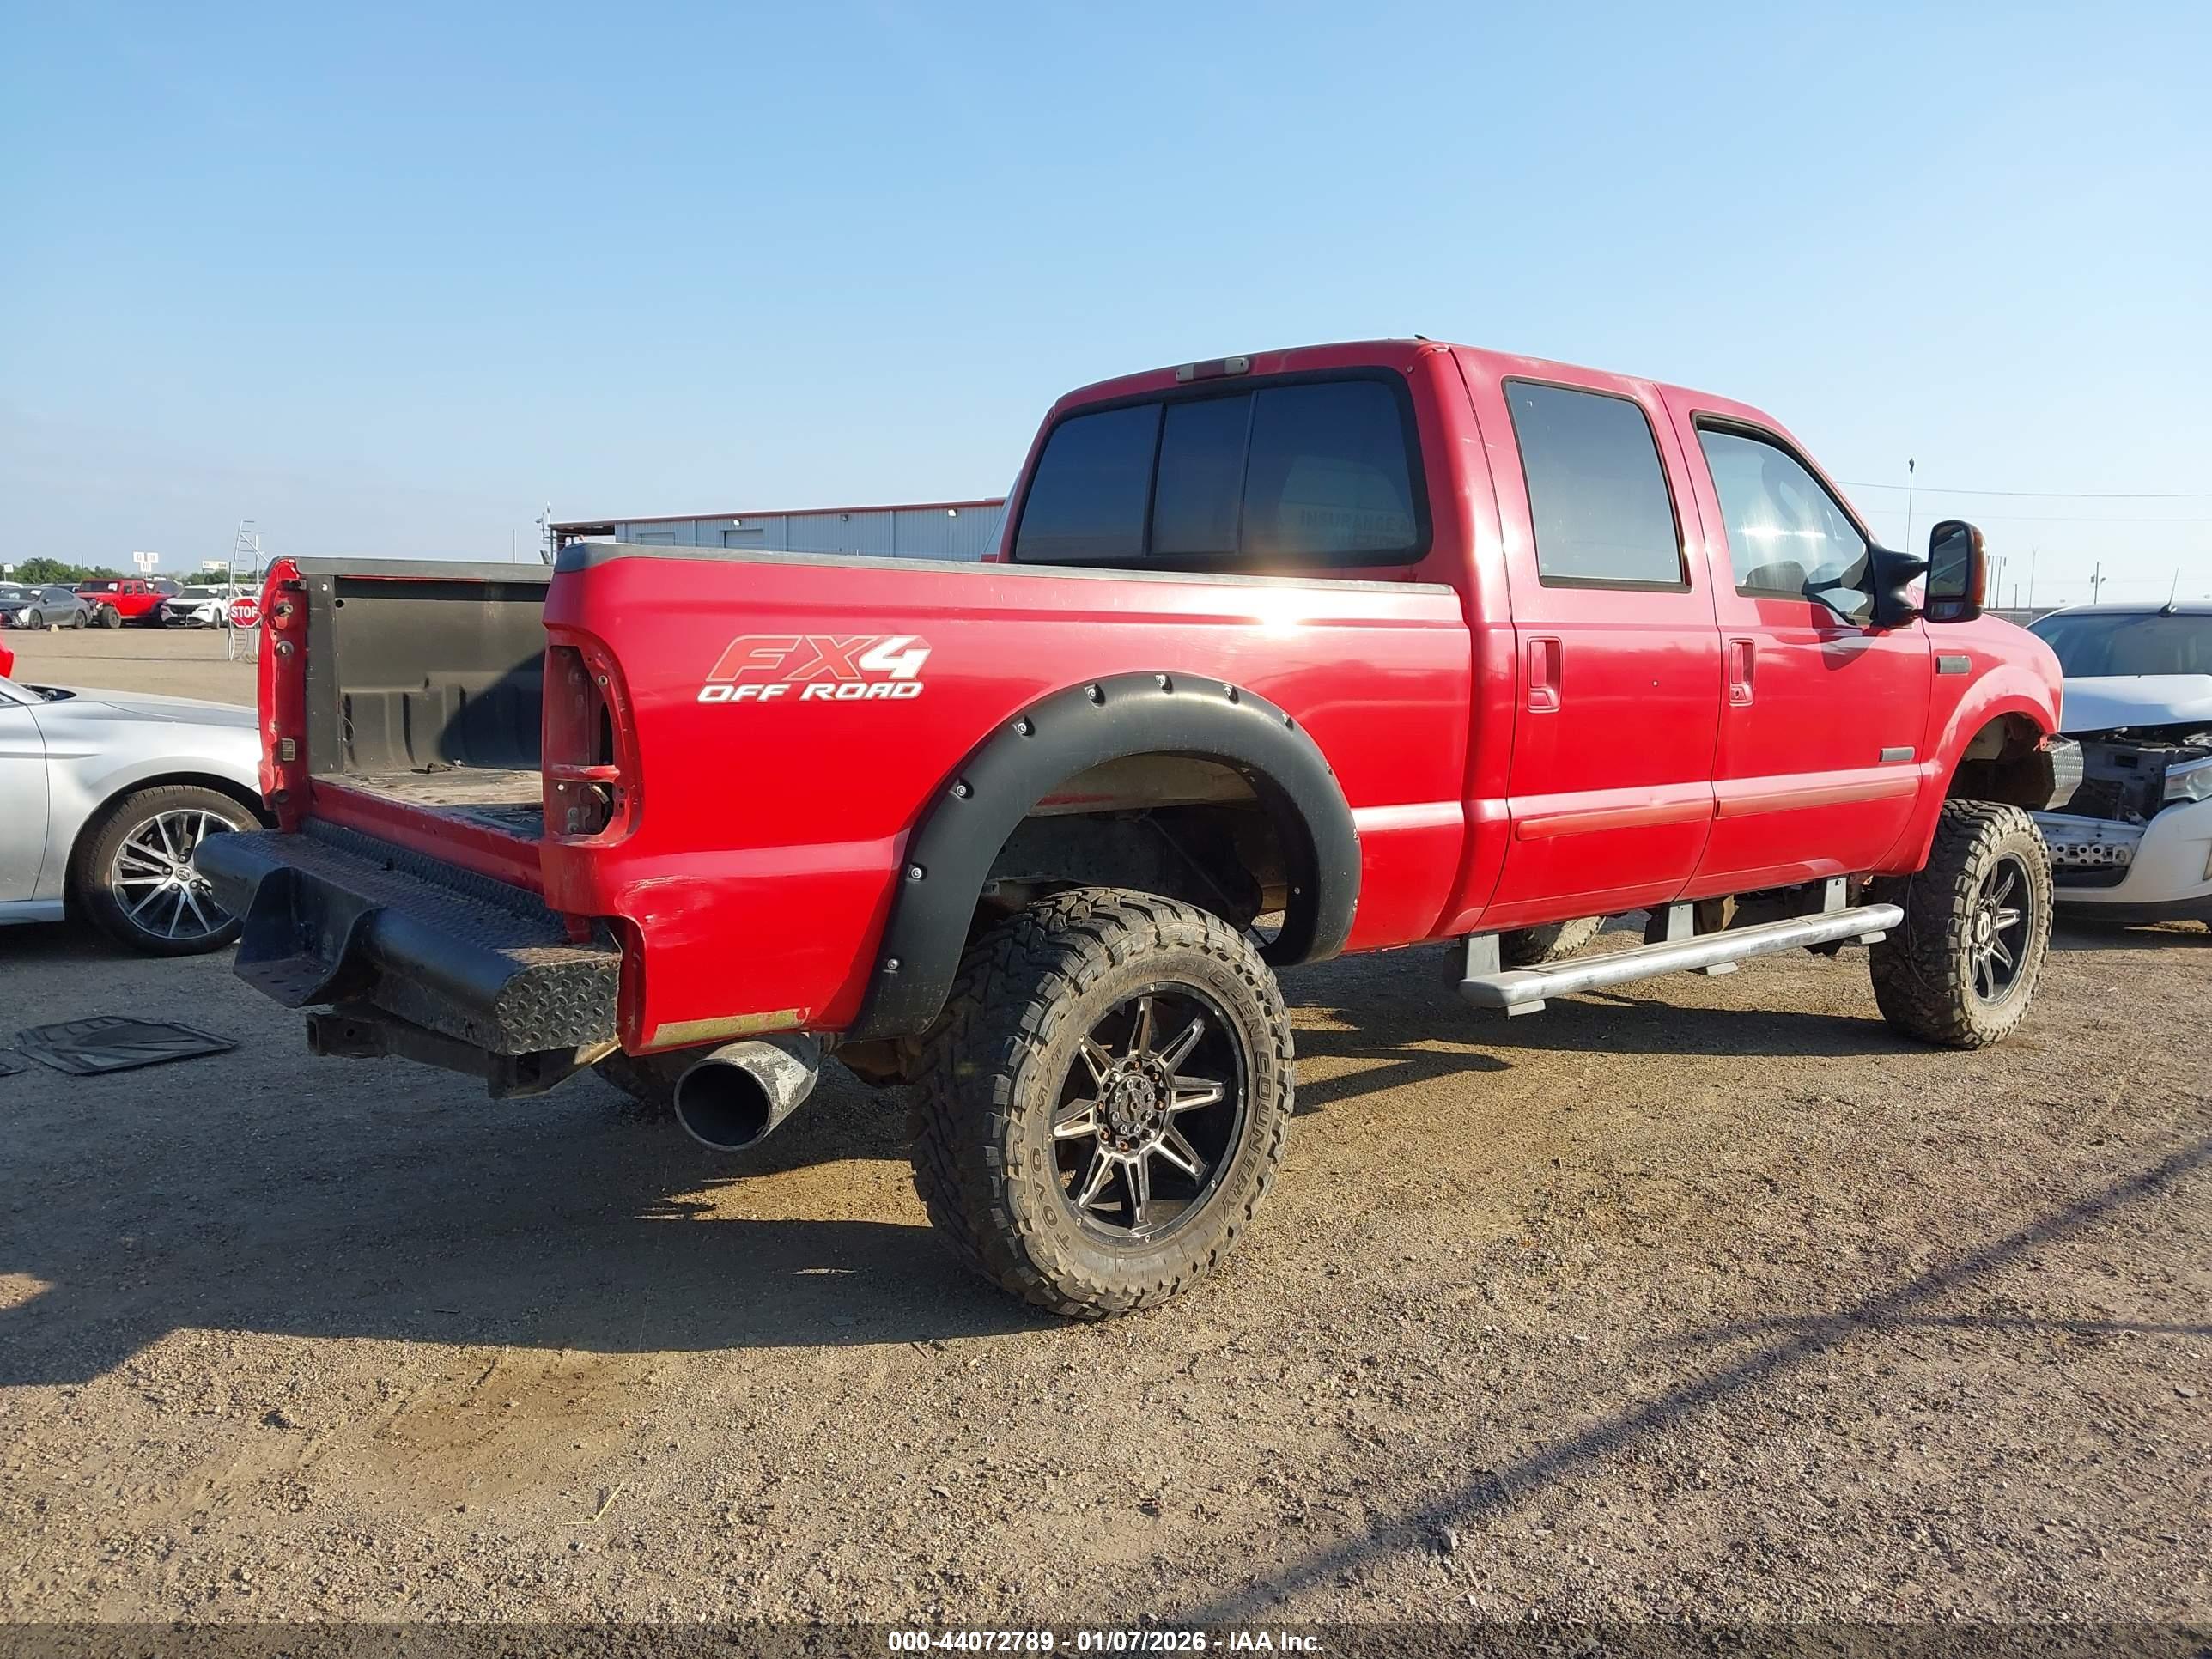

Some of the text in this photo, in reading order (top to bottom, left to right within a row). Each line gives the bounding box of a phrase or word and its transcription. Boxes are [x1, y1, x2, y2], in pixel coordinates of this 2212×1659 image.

[1301, 508, 1395, 532] INSURANCE
[705, 634, 932, 681] FX4
[696, 681, 925, 702] OFF ROAD
[1208, 967, 1272, 1222] OPEN COUNTRY
[1030, 1037, 1070, 1252] TOYO M/T
